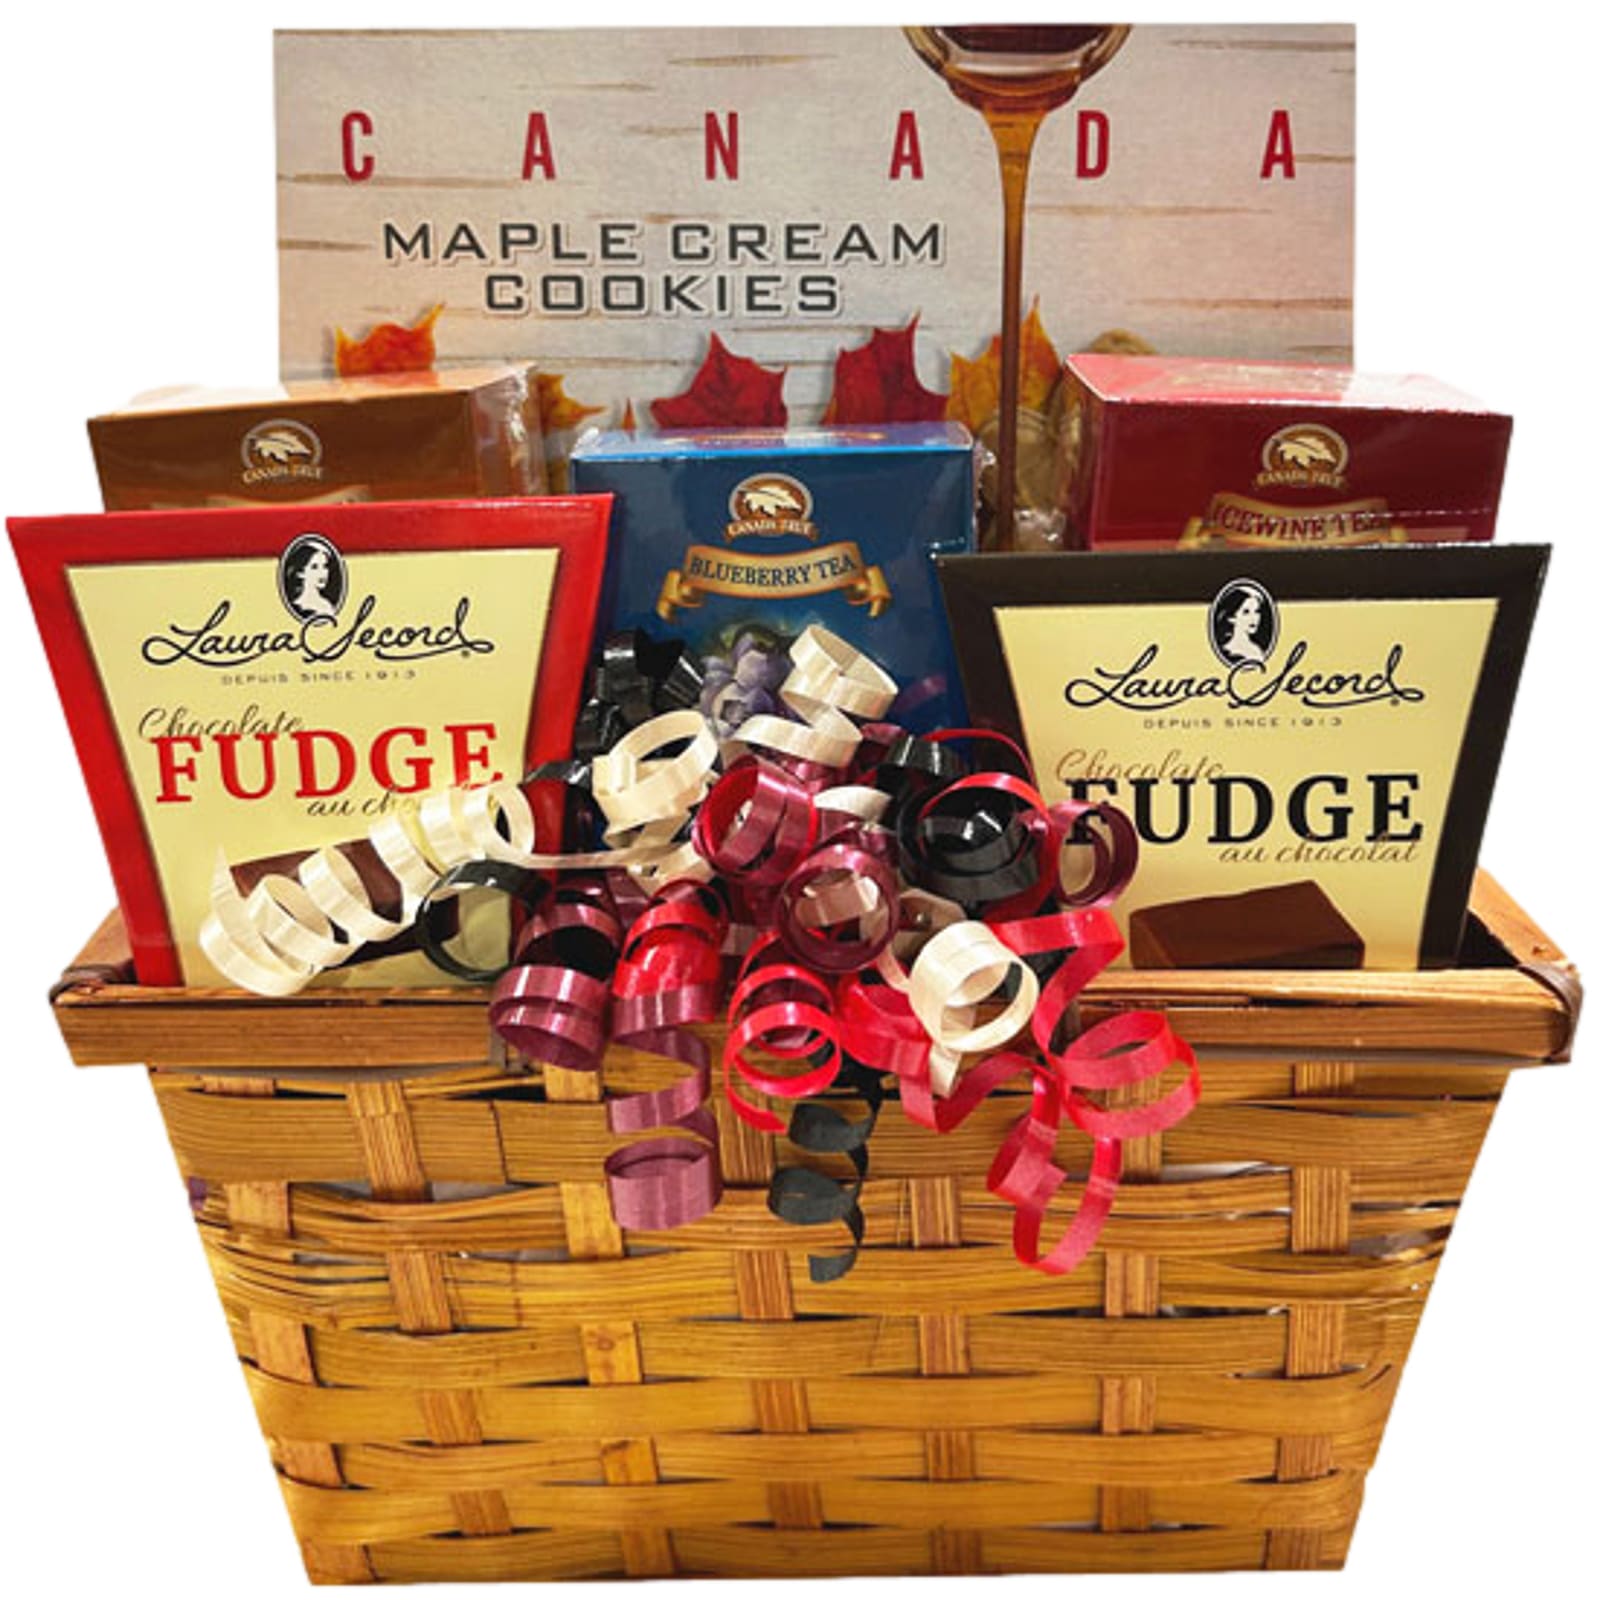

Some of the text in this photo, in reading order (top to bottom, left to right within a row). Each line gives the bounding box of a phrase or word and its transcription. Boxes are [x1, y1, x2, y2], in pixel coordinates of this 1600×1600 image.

[341, 110, 1296, 181] CANADA
[384, 222, 941, 262] MAPLE CREAM
[485, 274, 840, 314] COOKIES
[690, 553, 857, 586] BLUEBERRY TEA
[141, 594, 496, 668] Laura Secord
[222, 669, 418, 687] DEPUIS SINCE 1913
[1064, 640, 1426, 712] Laura Secord
[138, 703, 304, 739] Chocolate
[1143, 716, 1345, 731] DEPUIS SINCE 1913
[151, 722, 504, 804] FUDGE
[1055, 749, 1225, 781] Chocolate
[306, 797, 357, 818] au
[1065, 774, 1424, 845] FUDGE
[1217, 834, 1420, 864] au chocolat
